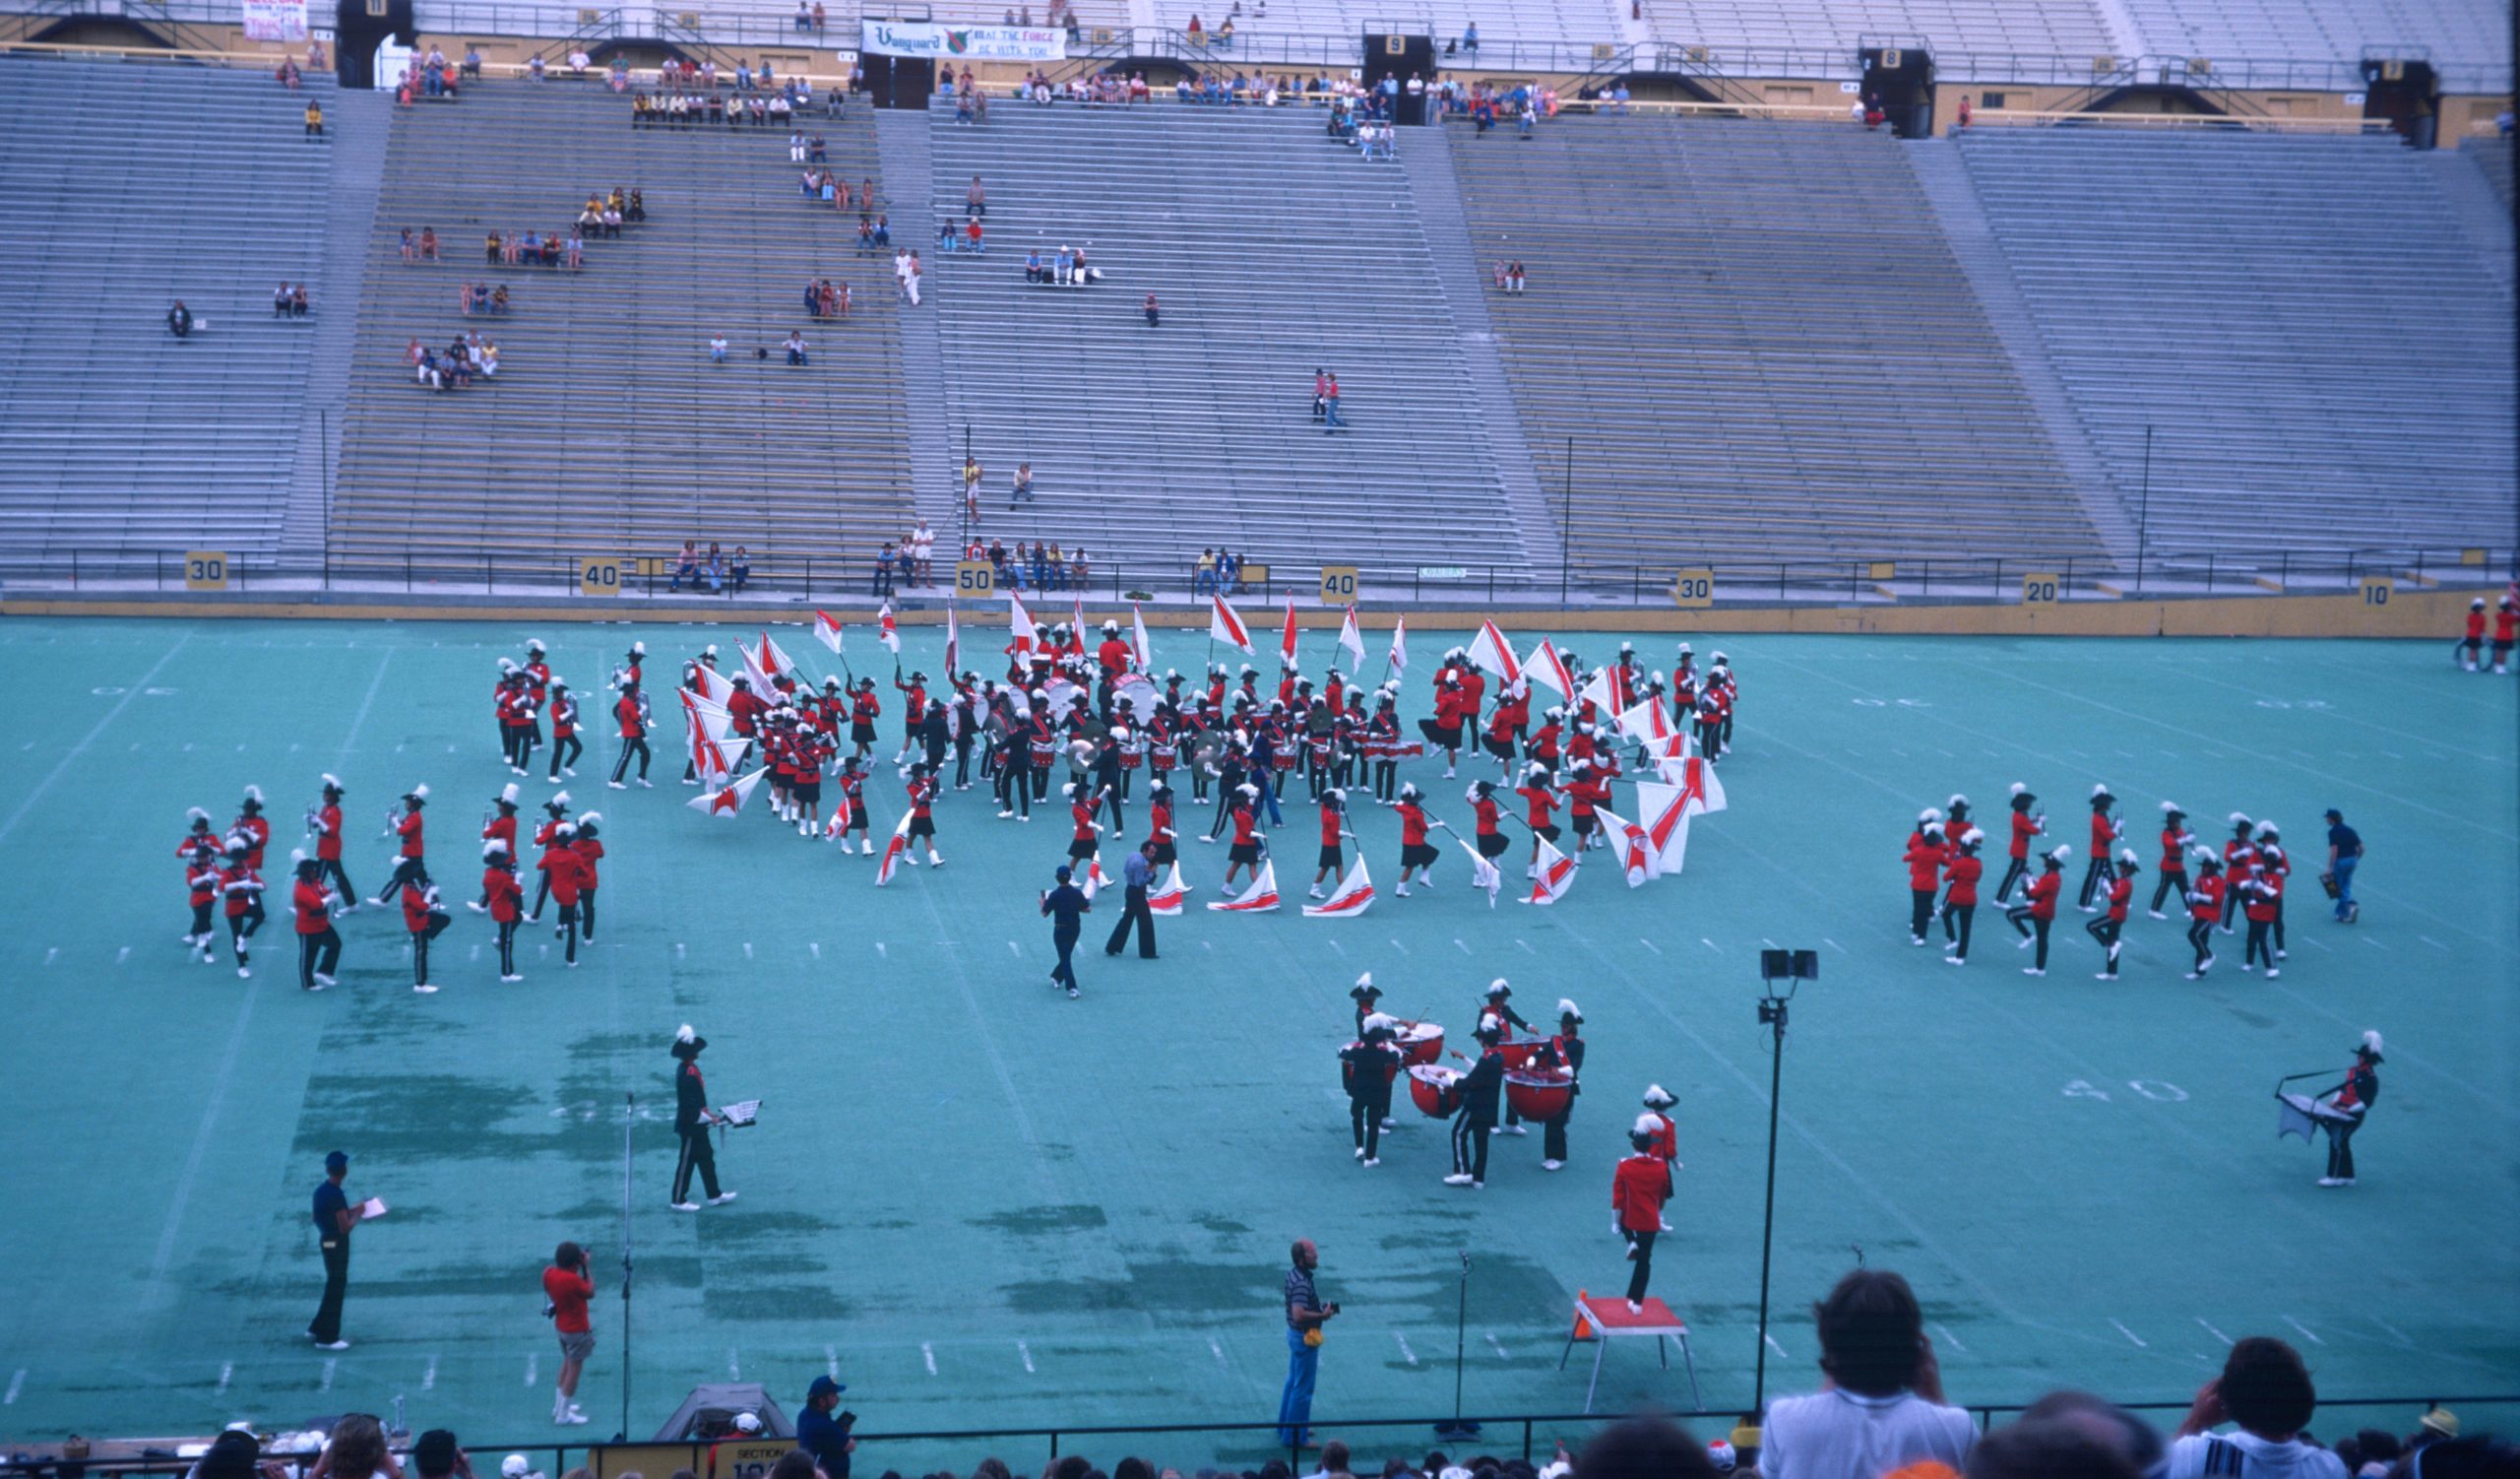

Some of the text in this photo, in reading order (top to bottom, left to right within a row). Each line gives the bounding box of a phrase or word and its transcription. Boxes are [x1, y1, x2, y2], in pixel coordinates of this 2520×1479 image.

[875, 27, 940, 52] Vanguard
[1023, 32, 1053, 41] FORCE
[1392, 37, 1401, 51] 9
[1029, 47, 1047, 57] YOU
[1886, 51, 1895, 64] 8
[191, 560, 220, 580] 30
[586, 566, 615, 585] 40
[961, 570, 988, 589] 50
[1325, 575, 1354, 594] 40
[1681, 580, 1708, 598] 30
[2028, 582, 2054, 601] 20
[2366, 586, 2387, 605] 10
[737, 1448, 786, 1459] SECTION
